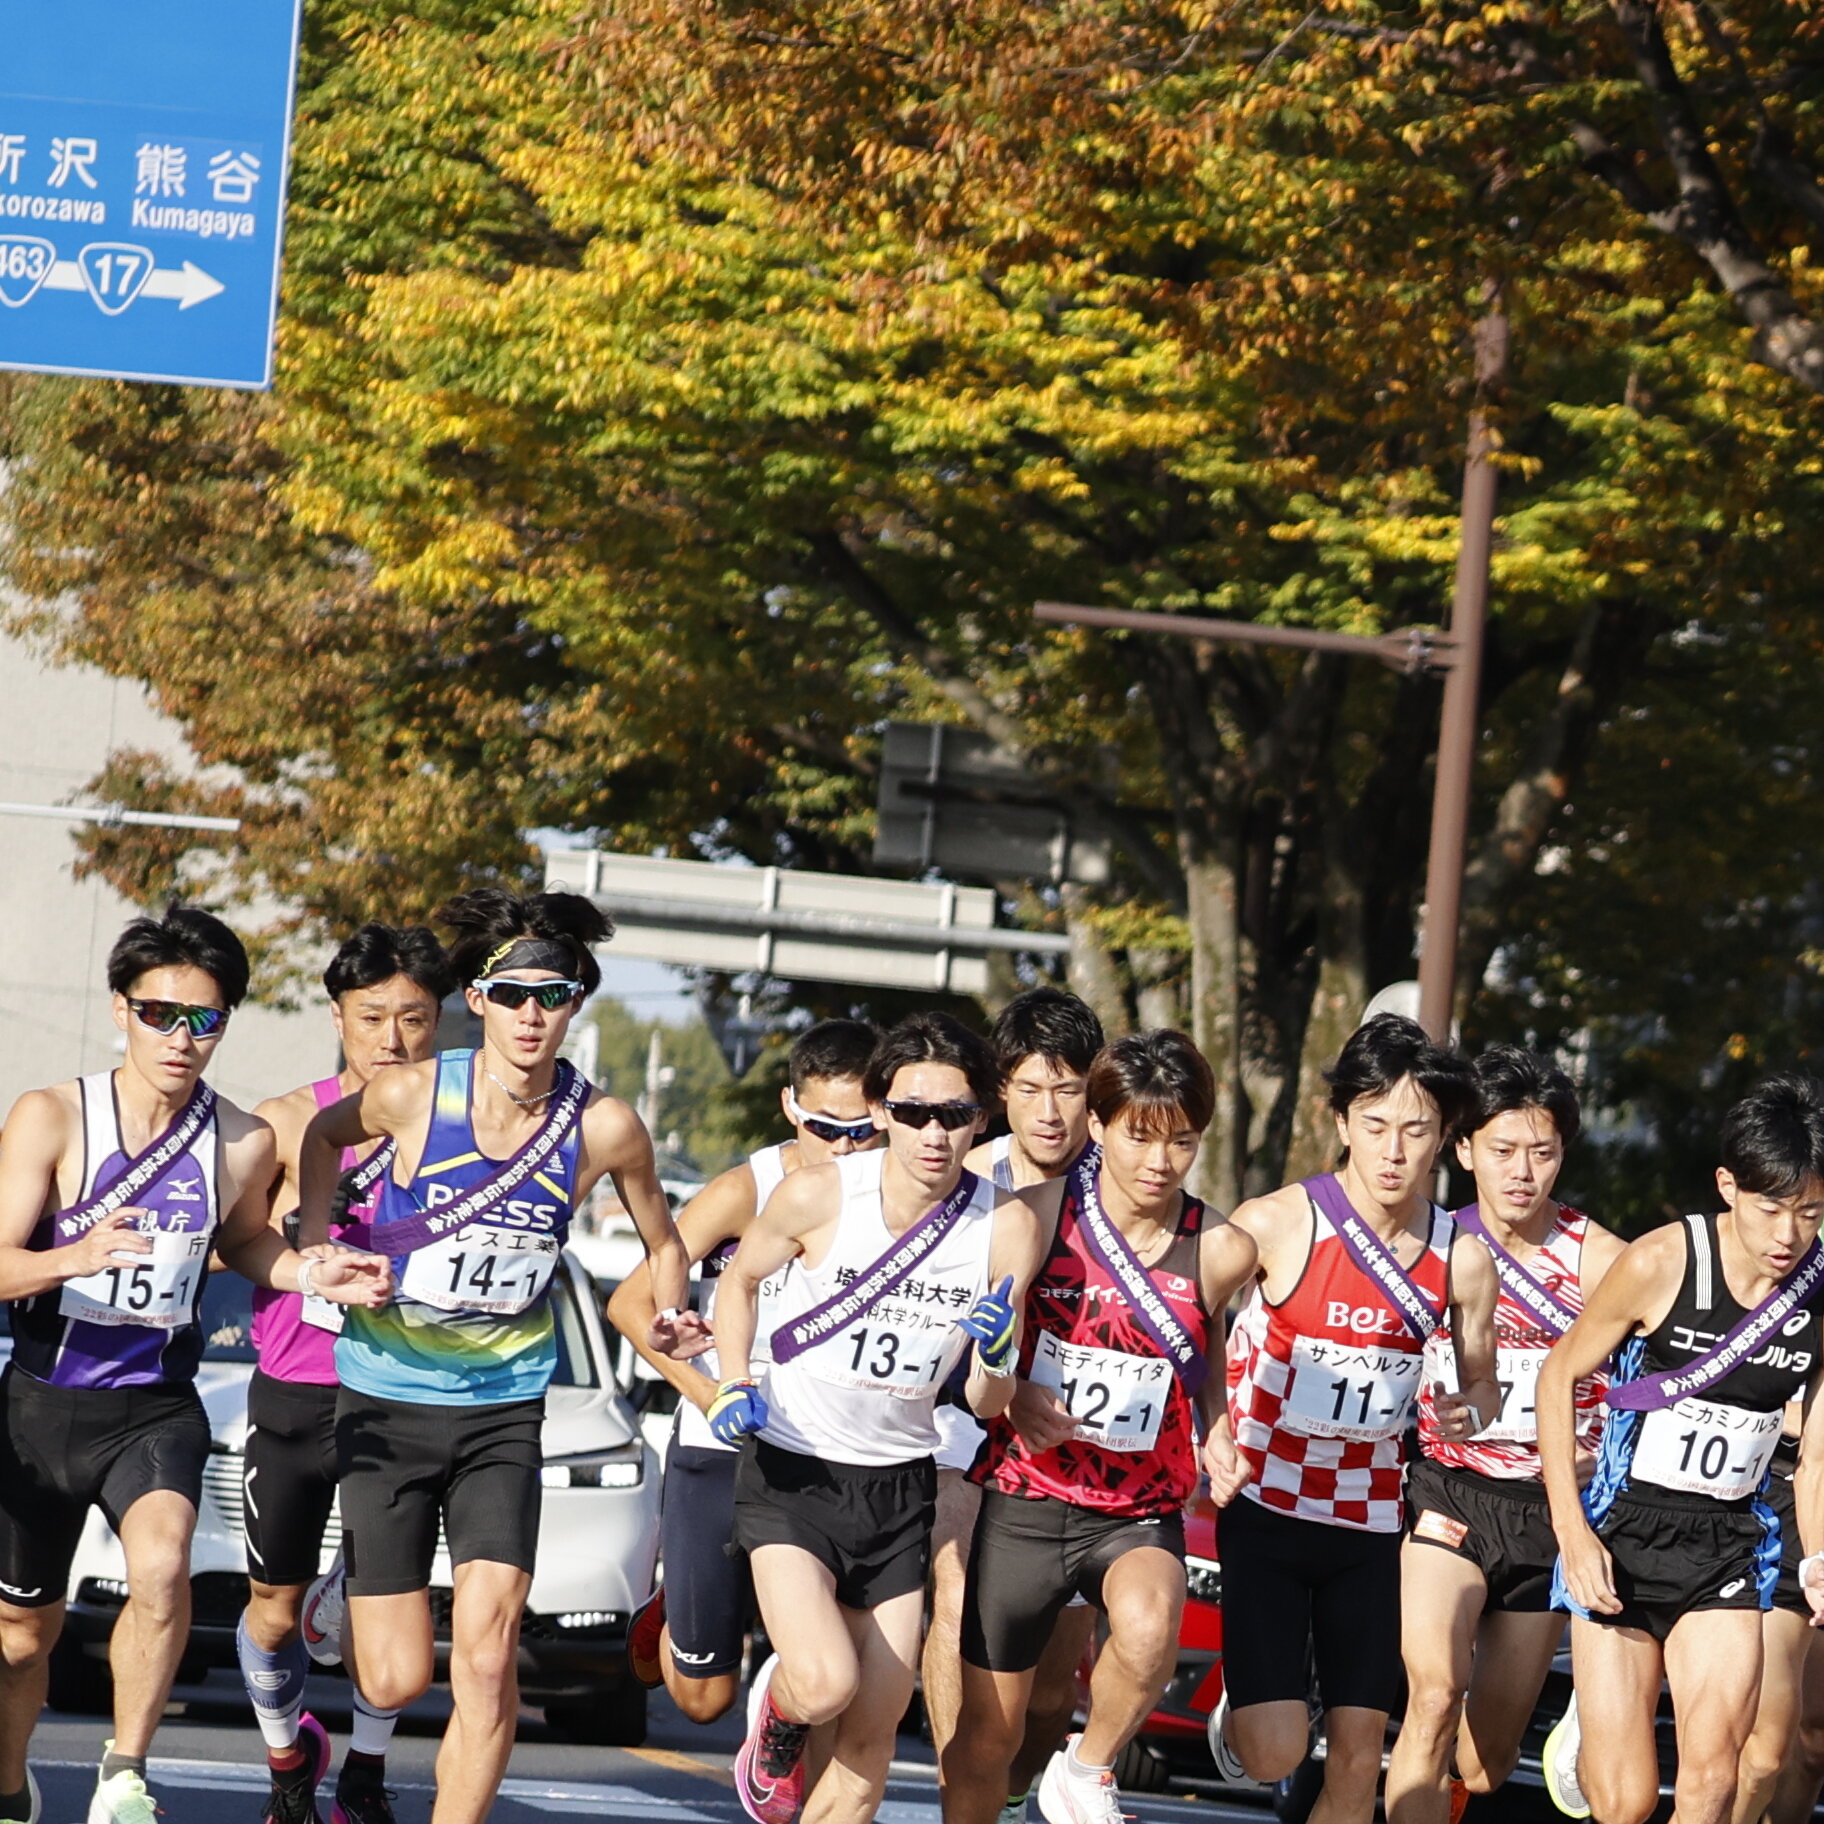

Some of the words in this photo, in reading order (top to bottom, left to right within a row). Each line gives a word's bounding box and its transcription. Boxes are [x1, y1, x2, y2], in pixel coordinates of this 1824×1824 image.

[135, 142, 261, 202] 熊谷
[132, 199, 255, 240] Kumagaya
[95, 253, 140, 297] 17
[448, 1252, 538, 1298] 14-1
[850, 1327, 943, 1383] 13-1
[1043, 1339, 1165, 1381] コモディイイダ
[1679, 1430, 1765, 1481] 10-1
